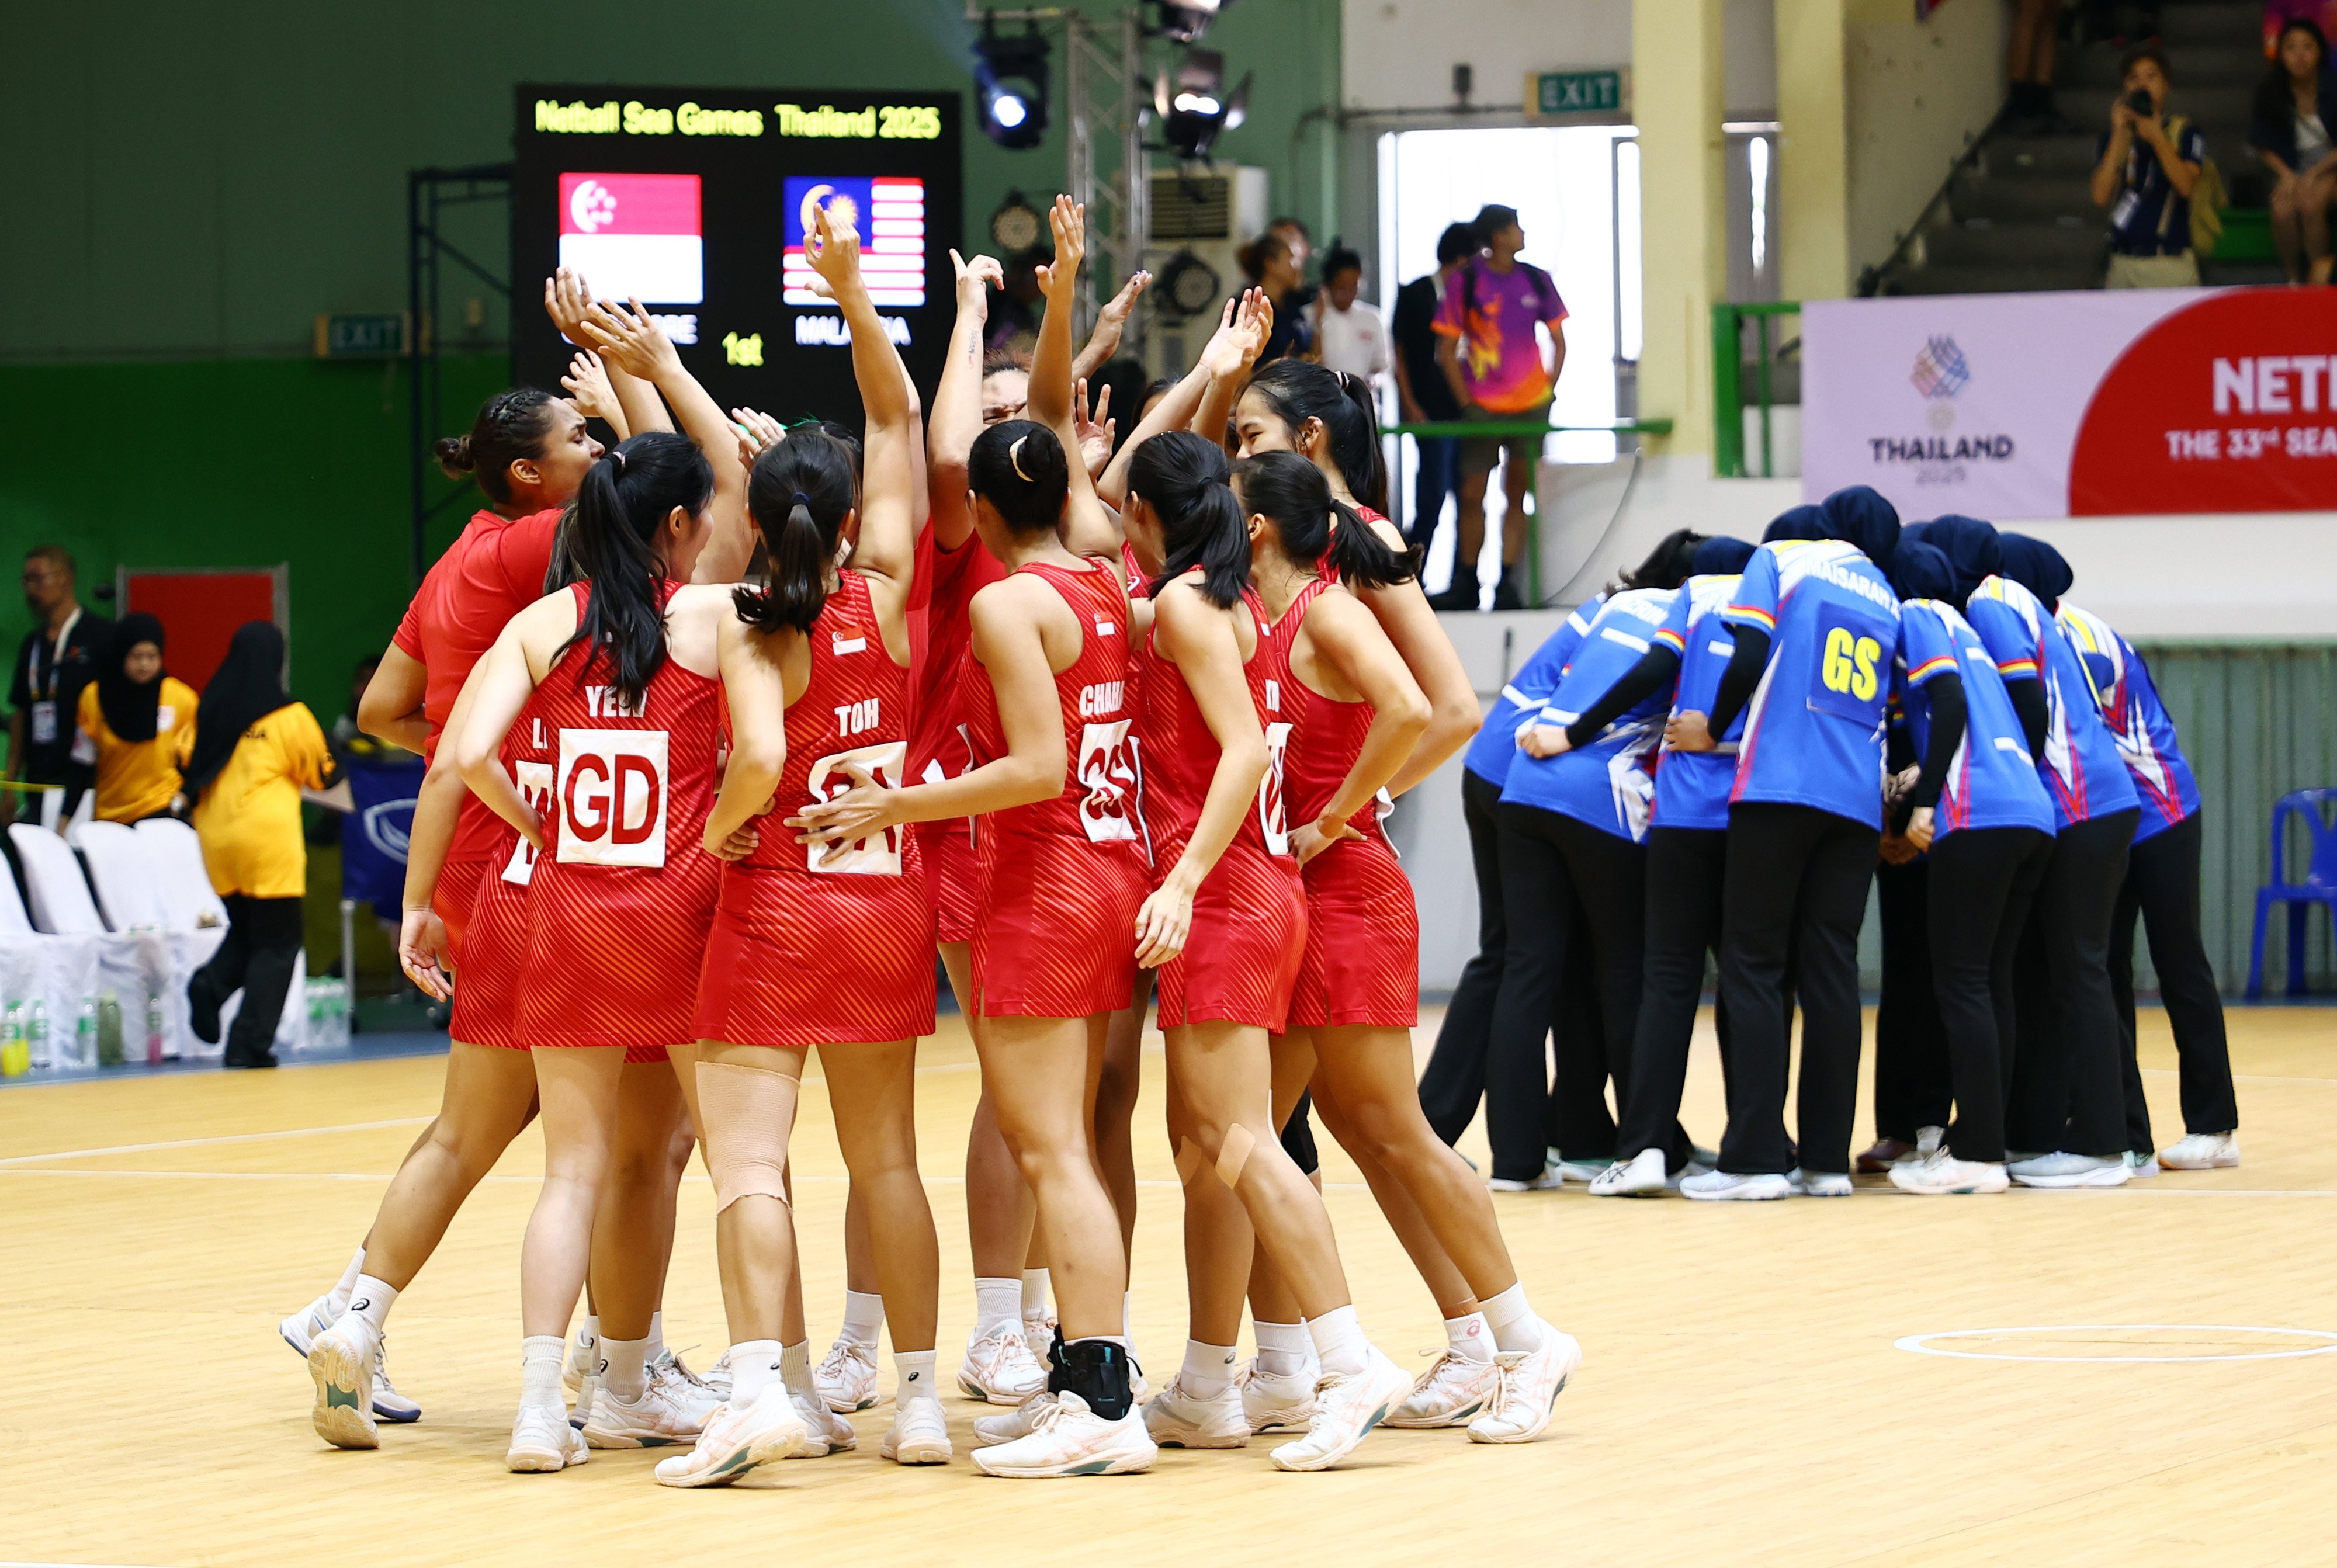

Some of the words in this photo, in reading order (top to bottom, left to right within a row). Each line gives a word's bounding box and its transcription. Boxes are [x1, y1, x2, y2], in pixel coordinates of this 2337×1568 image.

[1542, 77, 1613, 107] EXIT
[535, 99, 620, 133] Netball
[623, 100, 674, 135] Sea
[677, 102, 764, 137] Games
[774, 103, 876, 138] Thailand
[878, 106, 942, 140] 2025
[722, 331, 764, 367] 1st
[1868, 435, 2014, 462] THAILAND
[2165, 429, 2221, 461] THE
[1822, 626, 1882, 703] GS
[834, 697, 879, 737] TOH
[564, 752, 660, 844] GD
